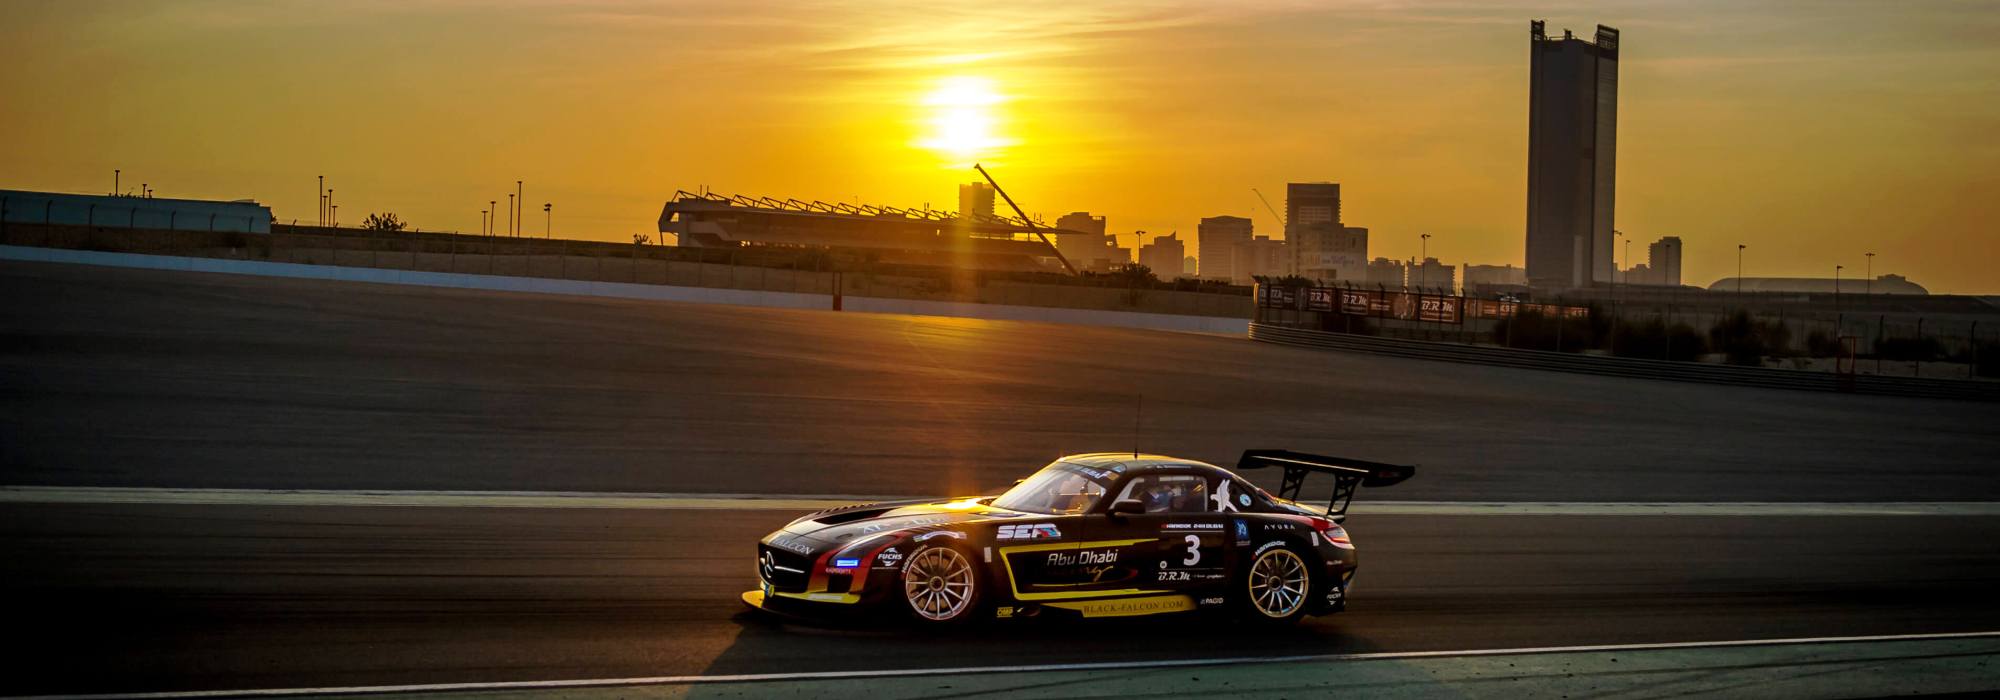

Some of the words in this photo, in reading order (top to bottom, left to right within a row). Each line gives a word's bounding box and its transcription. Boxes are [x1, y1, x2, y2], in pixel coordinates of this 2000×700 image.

[1047, 553, 1076, 567] Abu
[1079, 549, 1119, 566] Dhabi
[1183, 534, 1201, 566] 3
